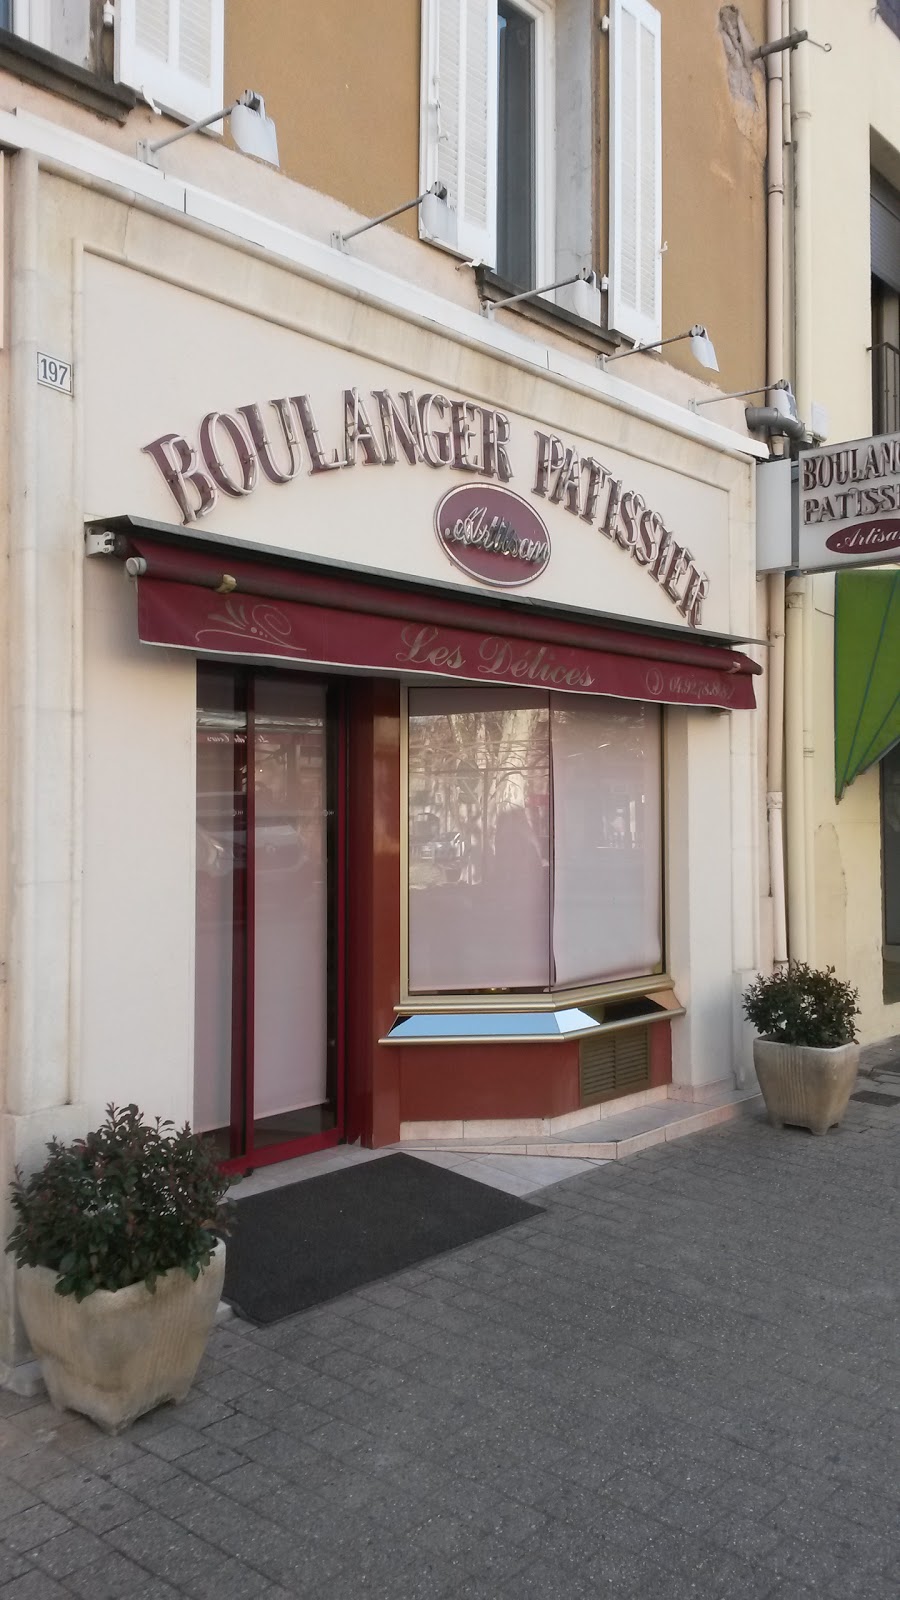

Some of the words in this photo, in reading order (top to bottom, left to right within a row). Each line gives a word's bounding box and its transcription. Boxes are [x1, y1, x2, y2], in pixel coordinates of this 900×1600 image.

[40, 358, 68, 385] 197
[801, 440, 900, 491] BOULAN
[140, 386, 514, 526] BOULANGER
[531, 430, 711, 628] PATISSIER
[837, 527, 900, 549] Artisa
[395, 622, 466, 669] Les
[477, 635, 596, 688] Délices
